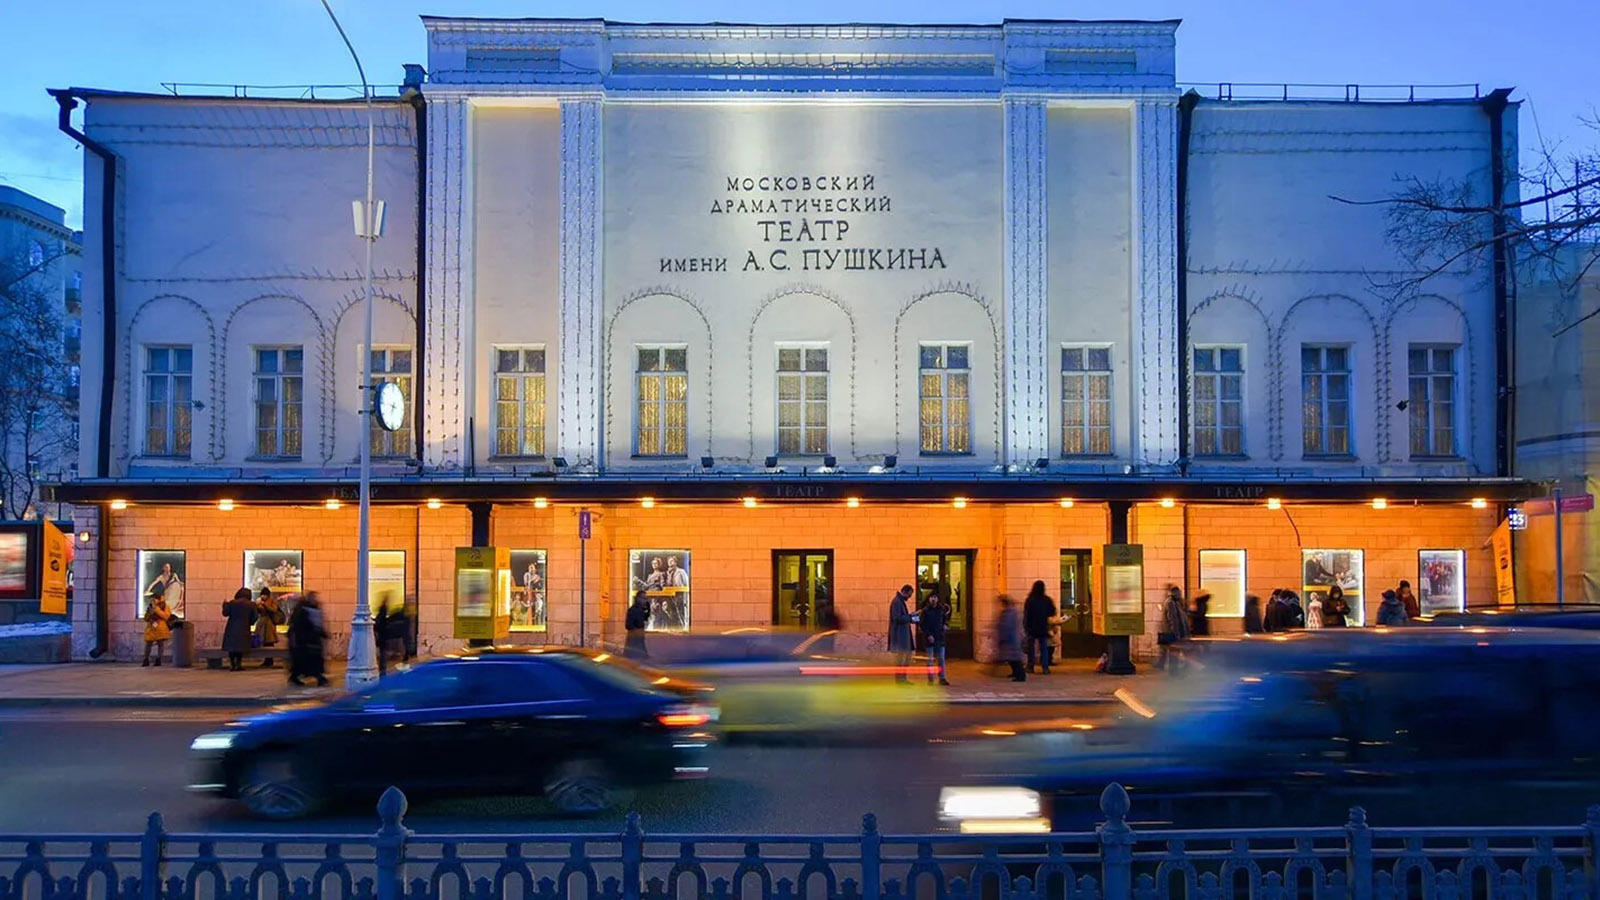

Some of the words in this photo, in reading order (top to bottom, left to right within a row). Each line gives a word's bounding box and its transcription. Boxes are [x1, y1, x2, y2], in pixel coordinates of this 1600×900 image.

[727, 174, 876, 192] МОСКОВСКИЙ
[710, 196, 892, 213] ДРАМАТИЧЕСКИЙ
[757, 219, 850, 242] ТЕАТР
[660, 258, 727, 273] ИМЕНИ
[802, 248, 948, 271] ПУШКИНА
[328, 486, 379, 499] ТЕАР
[774, 485, 824, 497] ТЕАТР
[1214, 486, 1264, 498] ТЕАТР
